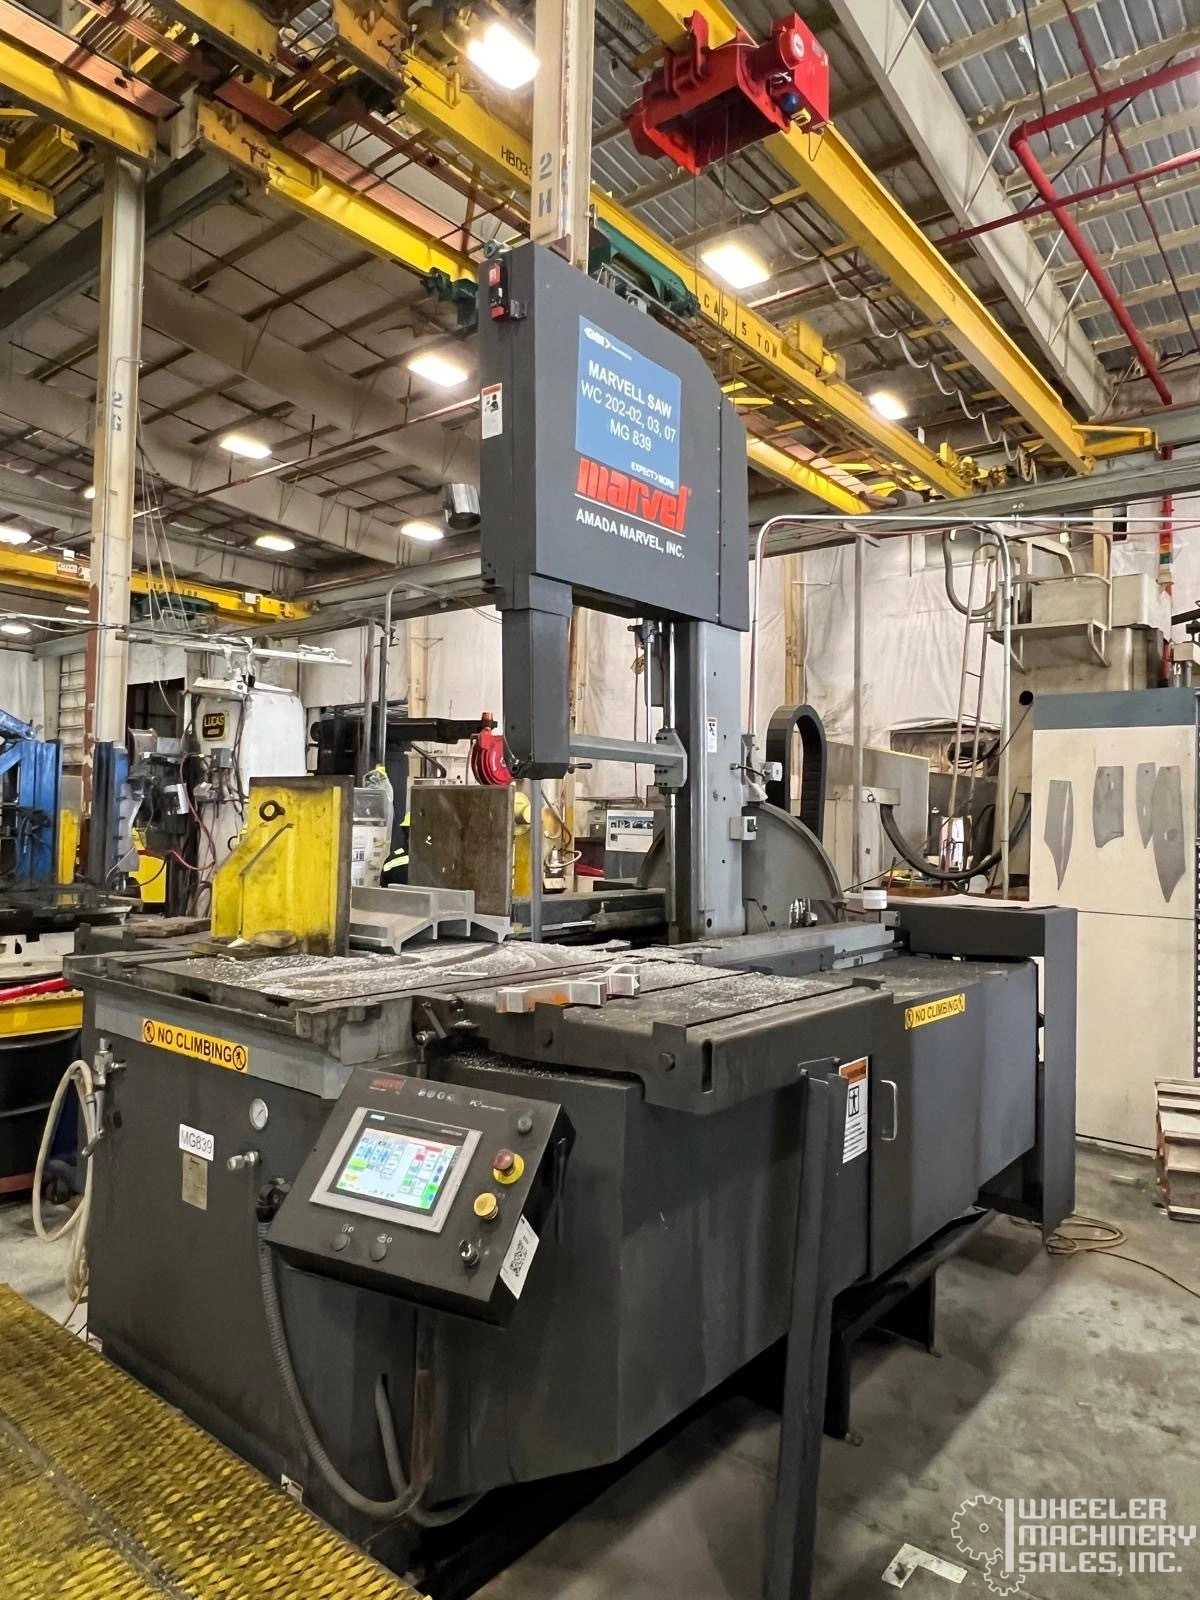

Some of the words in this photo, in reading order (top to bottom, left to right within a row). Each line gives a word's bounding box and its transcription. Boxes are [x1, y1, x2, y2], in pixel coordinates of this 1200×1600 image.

[540, 152, 552, 181] 2
[538, 188, 552, 217] H
[703, 293, 729, 321] CAP
[741, 321, 747, 336] 5
[757, 332, 778, 359] TON
[588, 359, 646, 405] MARVELL
[647, 393, 672, 419] SAW
[581, 379, 602, 404] WC
[604, 393, 645, 430] 202-02,
[647, 415, 662, 438] 03,
[664, 425, 677, 443] 07
[610, 418, 630, 441] MG
[632, 430, 652, 452] 839
[575, 508, 618, 536] AMADA
[619, 523, 664, 553] MARVEL,
[666, 541, 685, 559] INC.
[915, 1008, 926, 1023] NO
[927, 999, 959, 1019] CLIMBING
[158, 1027, 174, 1045] NO
[176, 1032, 232, 1063] CLIMBING
[180, 1129, 213, 1155] MG839
